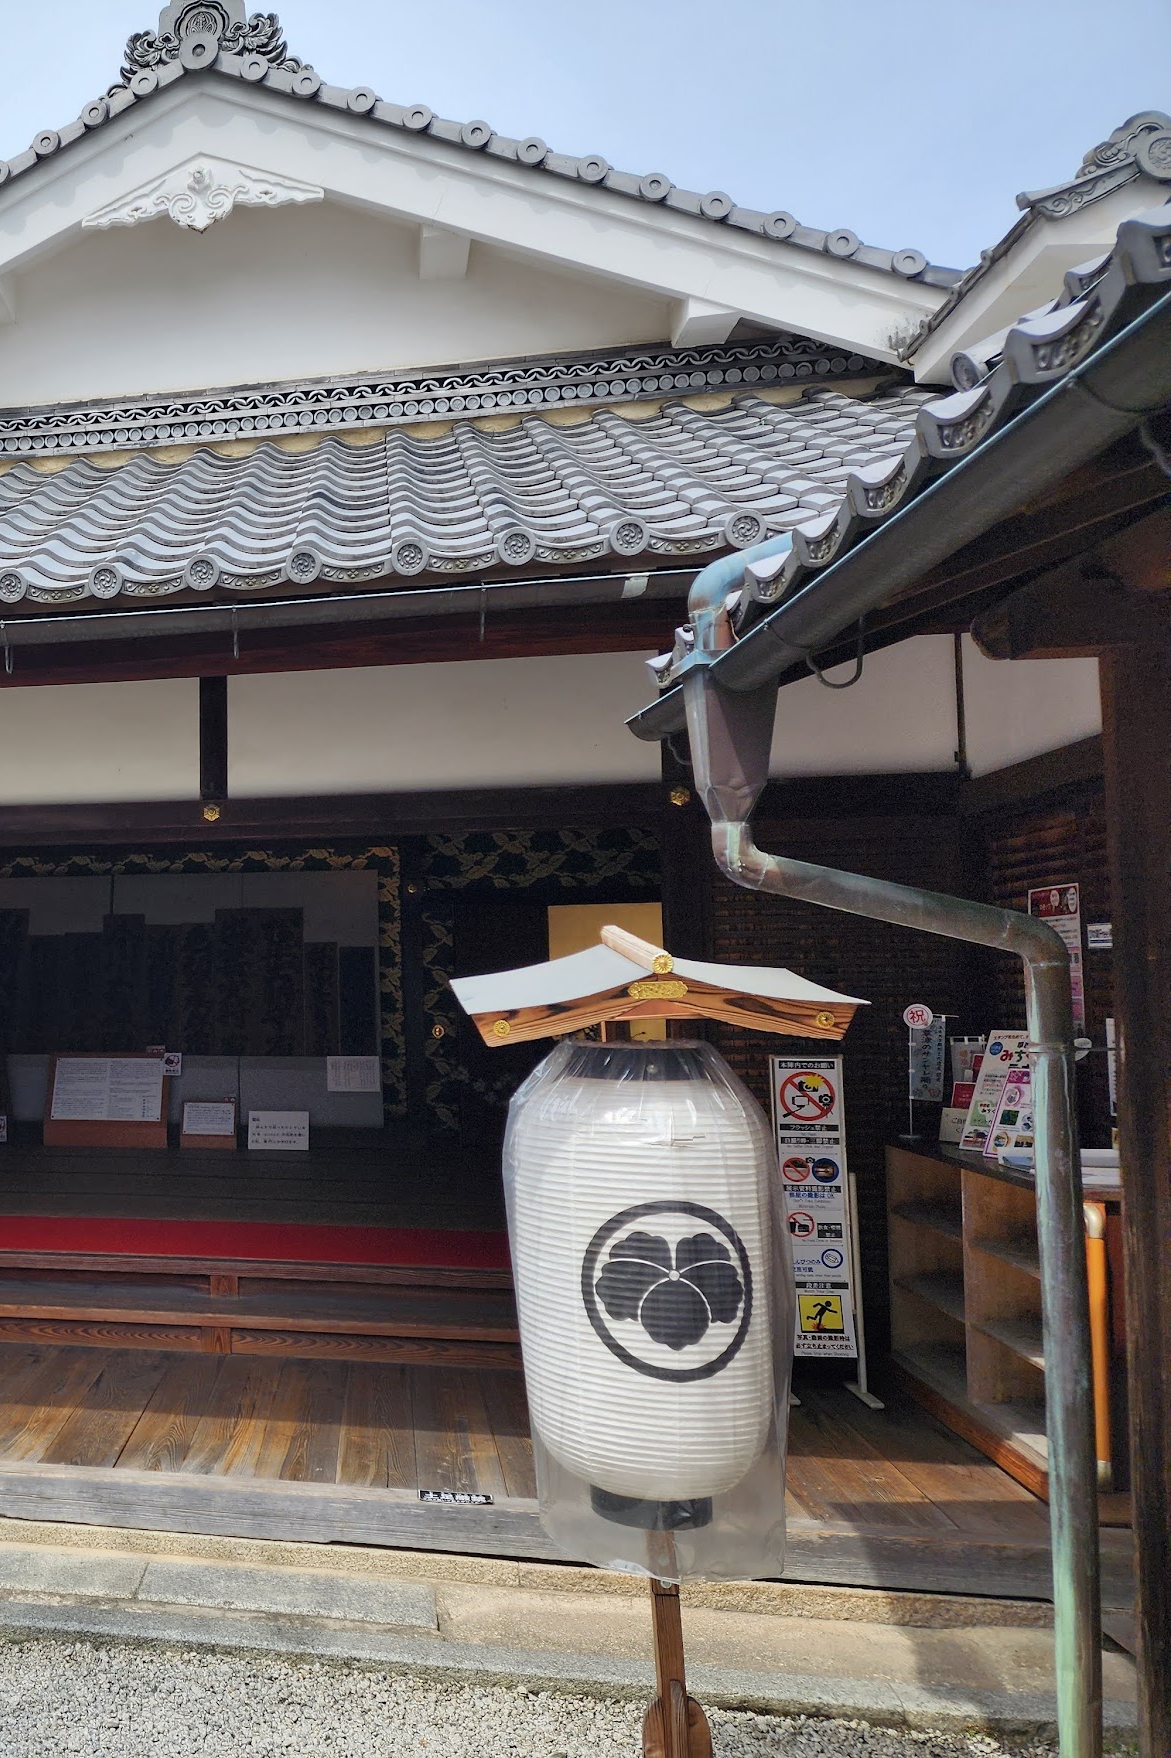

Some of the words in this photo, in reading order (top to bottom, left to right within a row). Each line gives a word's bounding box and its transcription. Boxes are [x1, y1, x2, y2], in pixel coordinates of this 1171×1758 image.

[909, 1010, 926, 1024] 祝
[797, 1334, 850, 1342] 写真・動画の撮影時は
[796, 1342, 854, 1350] 必ず立ち止まってください
